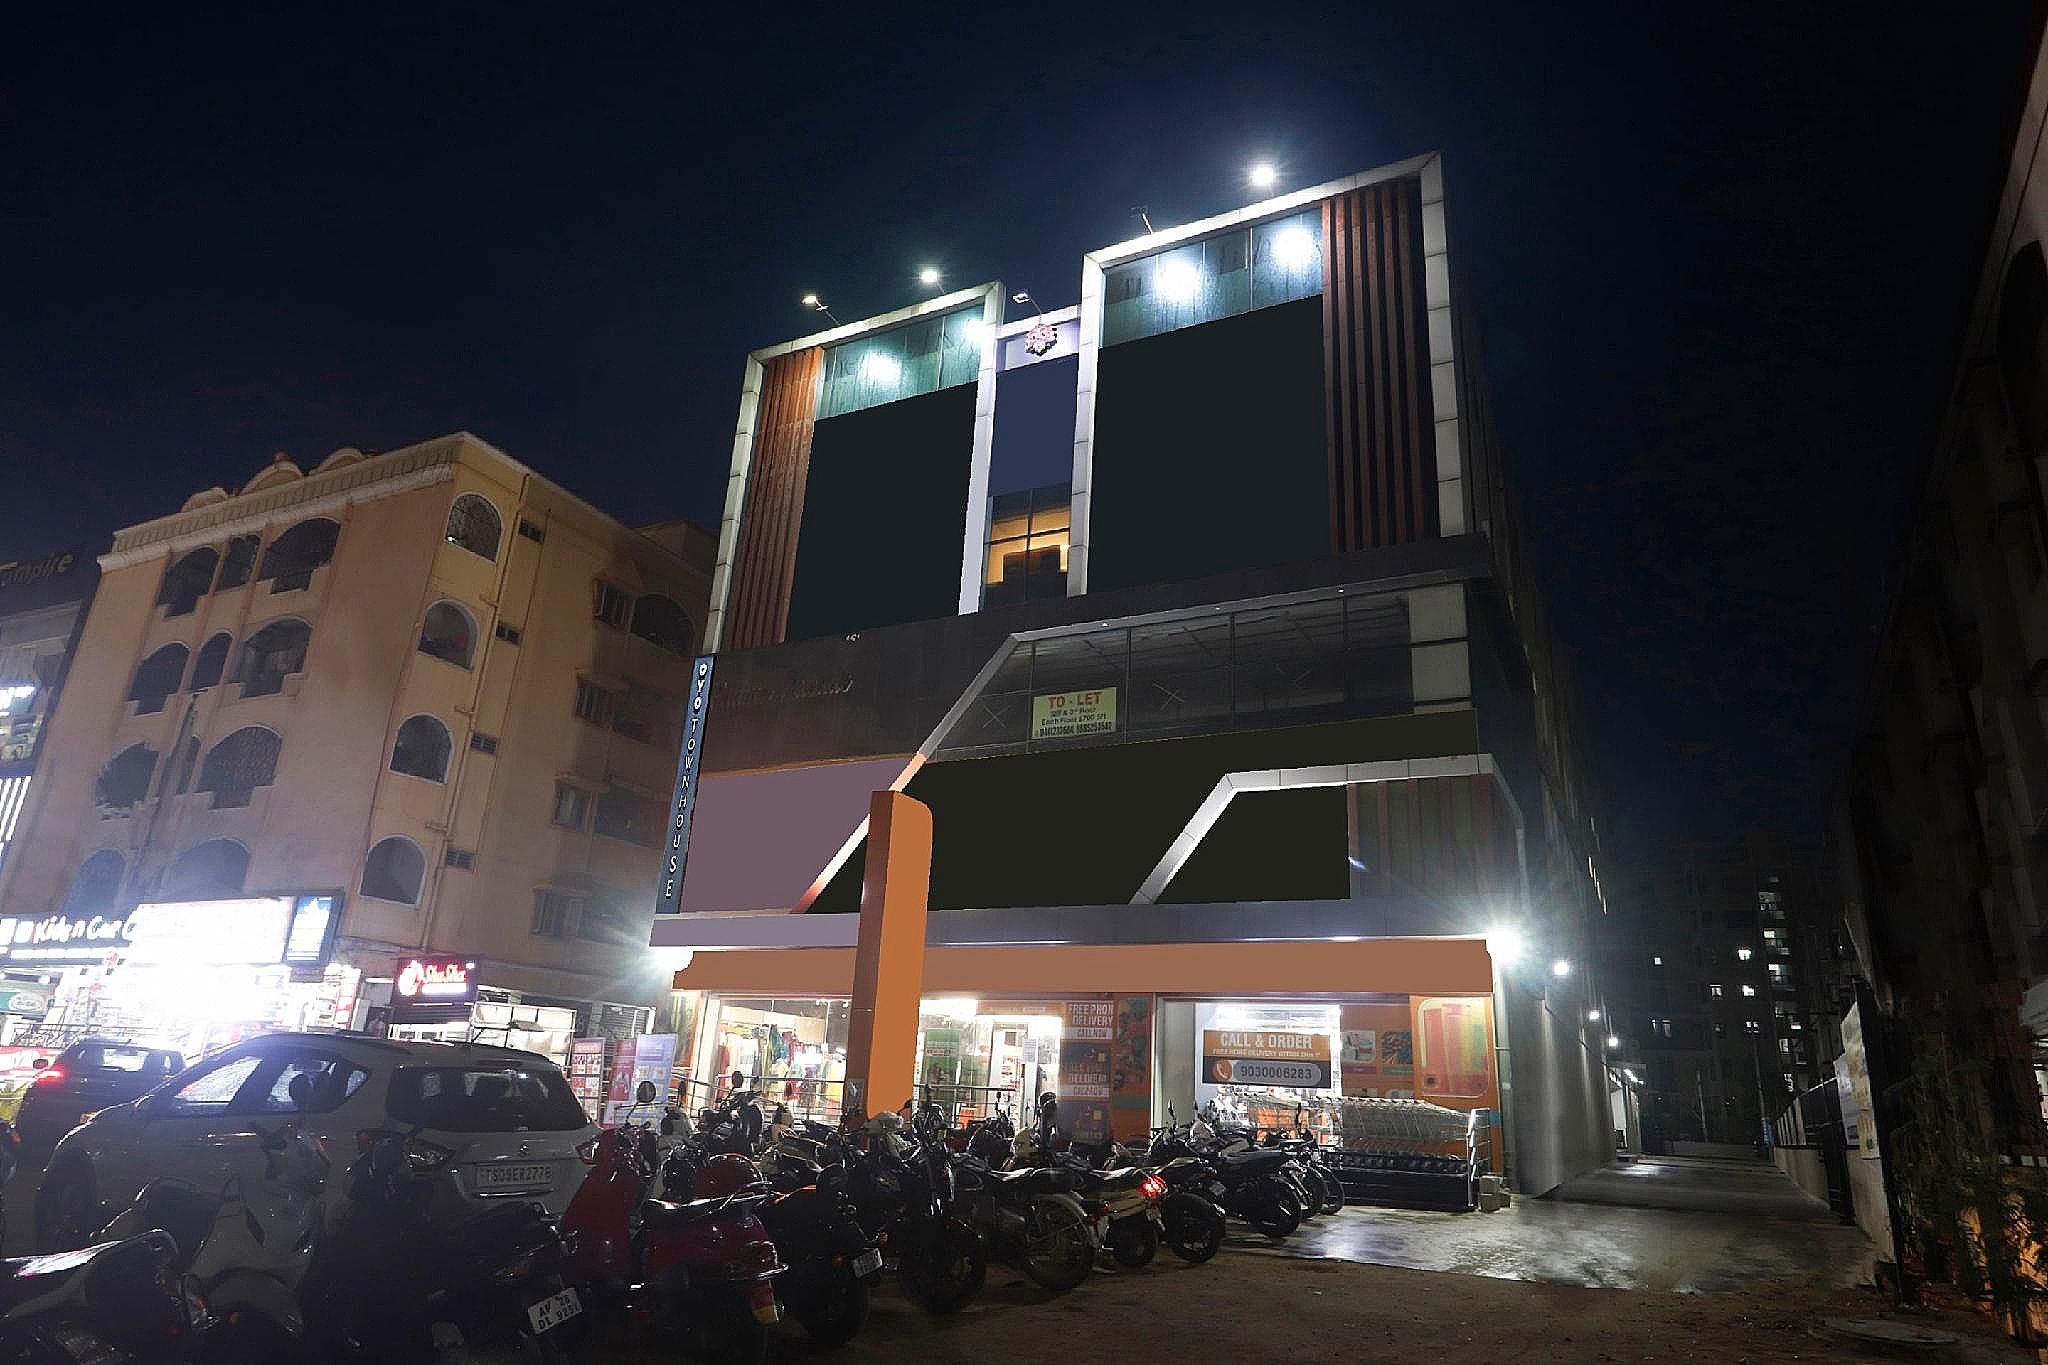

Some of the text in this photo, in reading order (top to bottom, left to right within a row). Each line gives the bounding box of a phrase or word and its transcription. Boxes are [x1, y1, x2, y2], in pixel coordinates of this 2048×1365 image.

[1048, 695, 1066, 709] TO
[1077, 692, 1103, 706] LET
[664, 718, 699, 898] TOWNHOUSE
[1072, 1015, 1114, 1027] DELIVERY
[1220, 1031, 1313, 1050] CALL & ORDER
